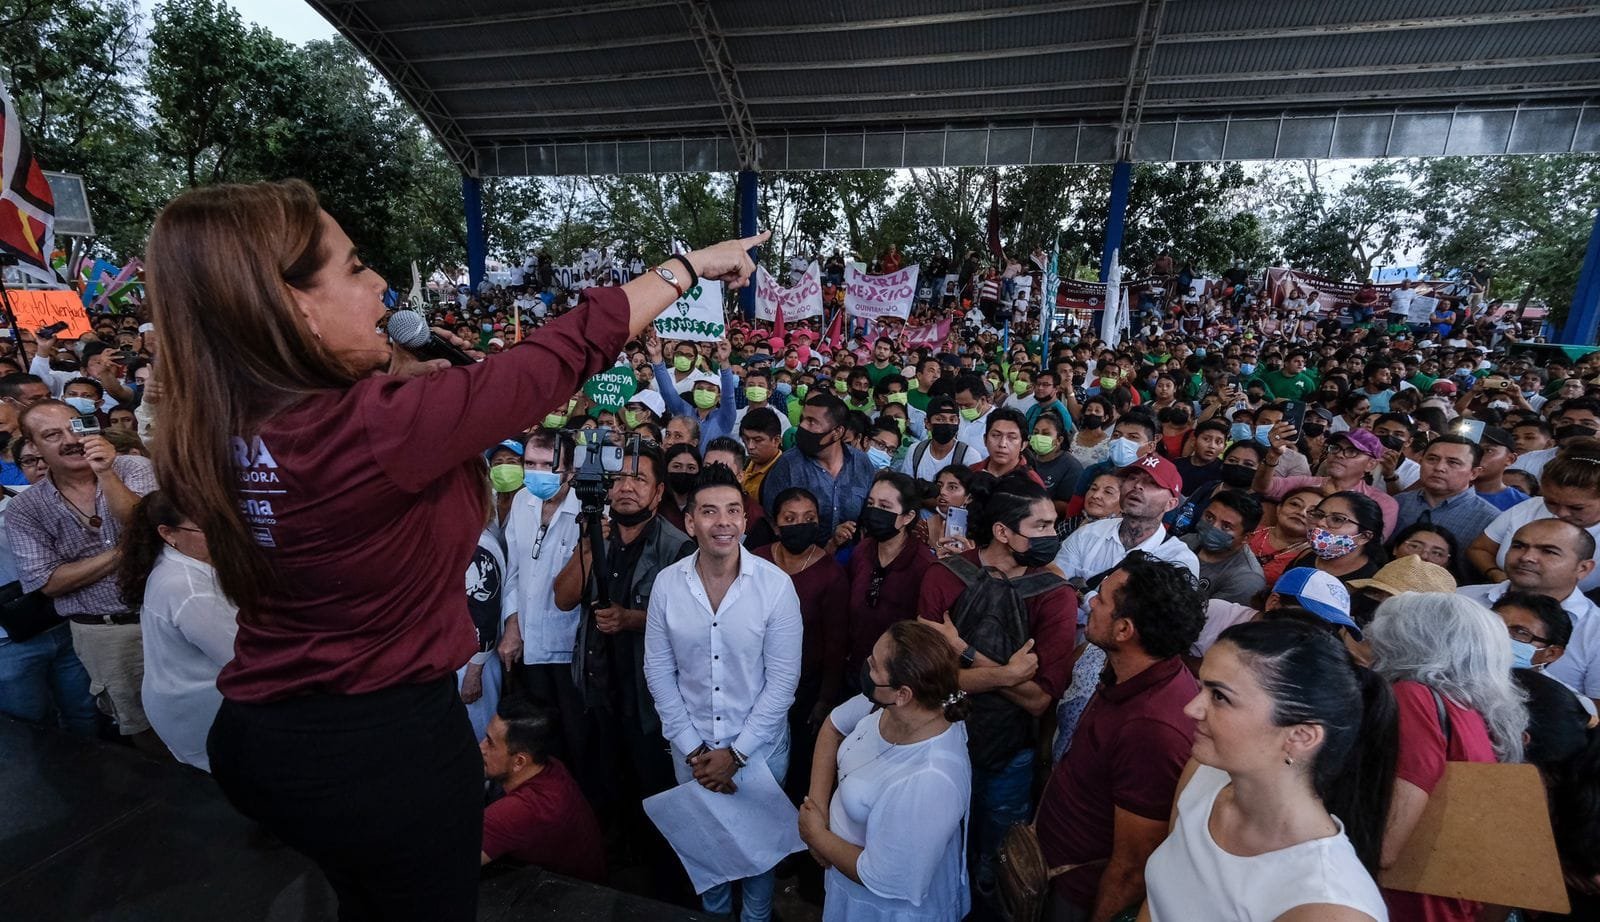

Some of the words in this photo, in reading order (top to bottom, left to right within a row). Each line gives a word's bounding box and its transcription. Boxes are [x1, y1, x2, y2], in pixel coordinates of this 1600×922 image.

[852, 269, 911, 288] FUERZA
[846, 283, 914, 302] MEXICO
[597, 382, 621, 394] CON
[593, 394, 625, 407] MARA
[1142, 456, 1160, 468] NY
